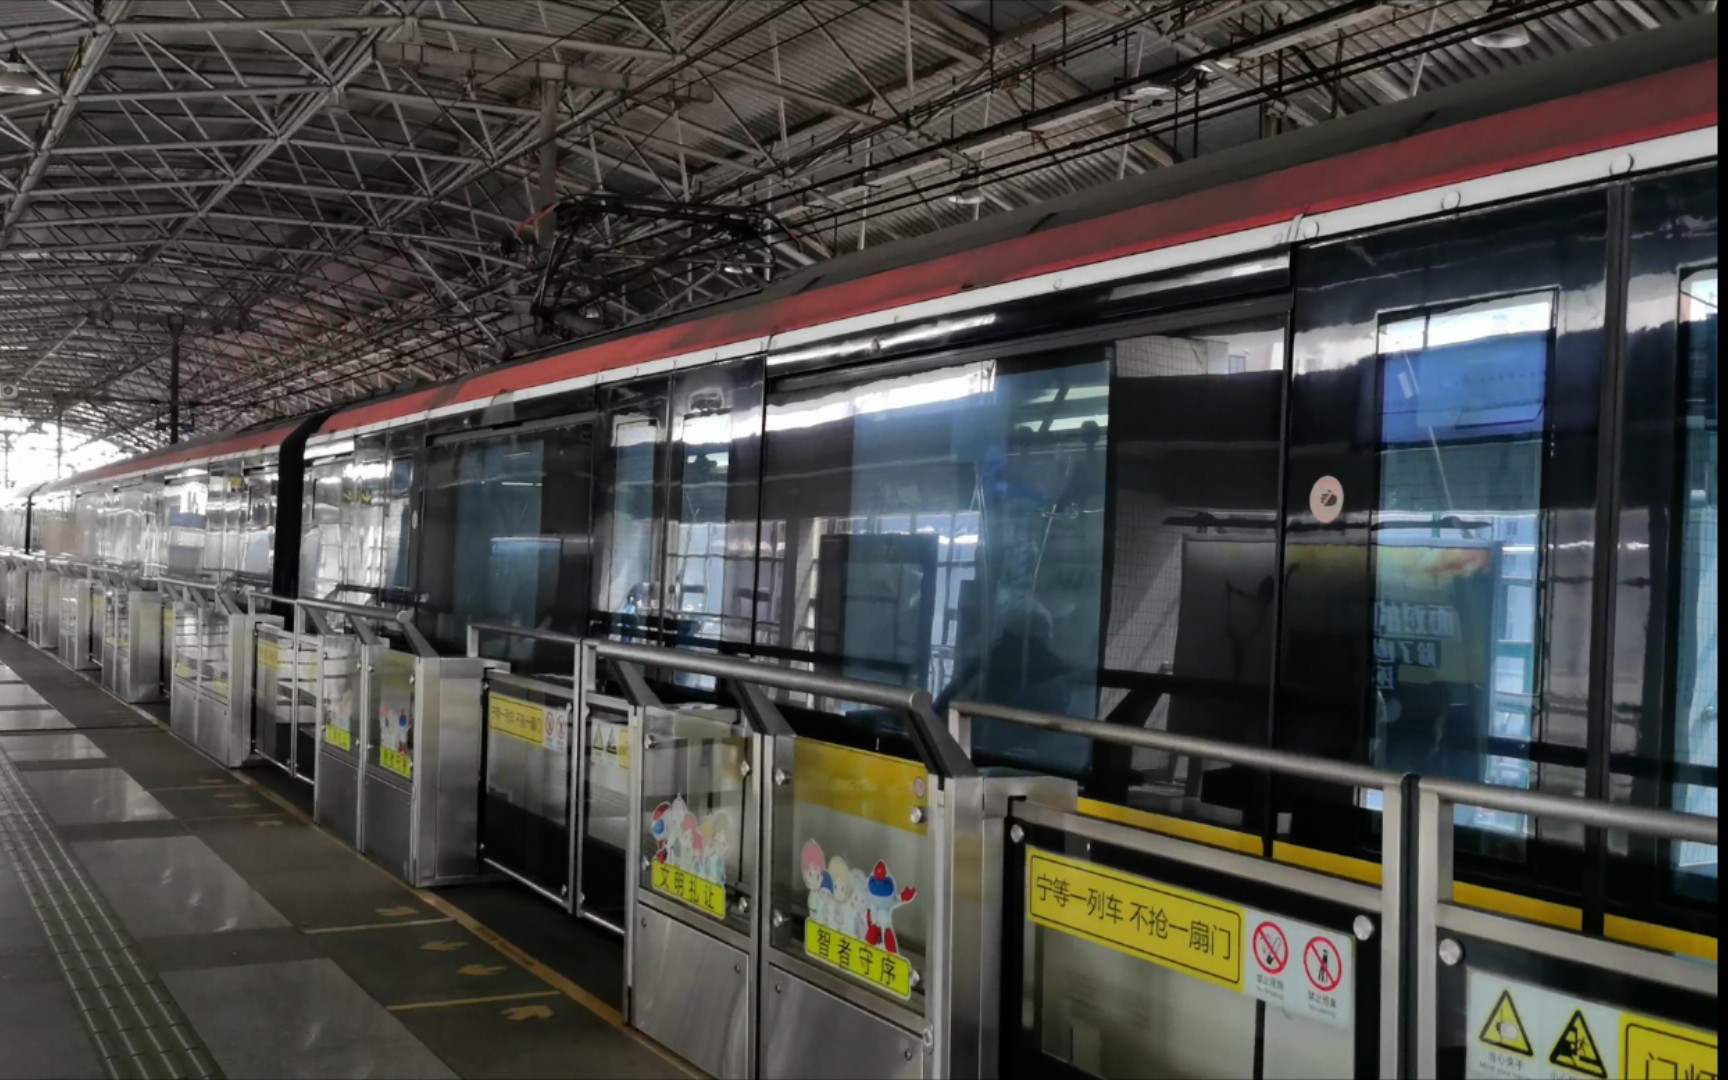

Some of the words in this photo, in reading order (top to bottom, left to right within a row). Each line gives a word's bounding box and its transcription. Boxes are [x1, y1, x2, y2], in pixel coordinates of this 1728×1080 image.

[659, 866, 715, 910] 文明礼让
[1036, 874, 1124, 924] 宁等一列车
[1129, 901, 1231, 960] 不抢一扇门
[816, 926, 897, 987] 智者守序
